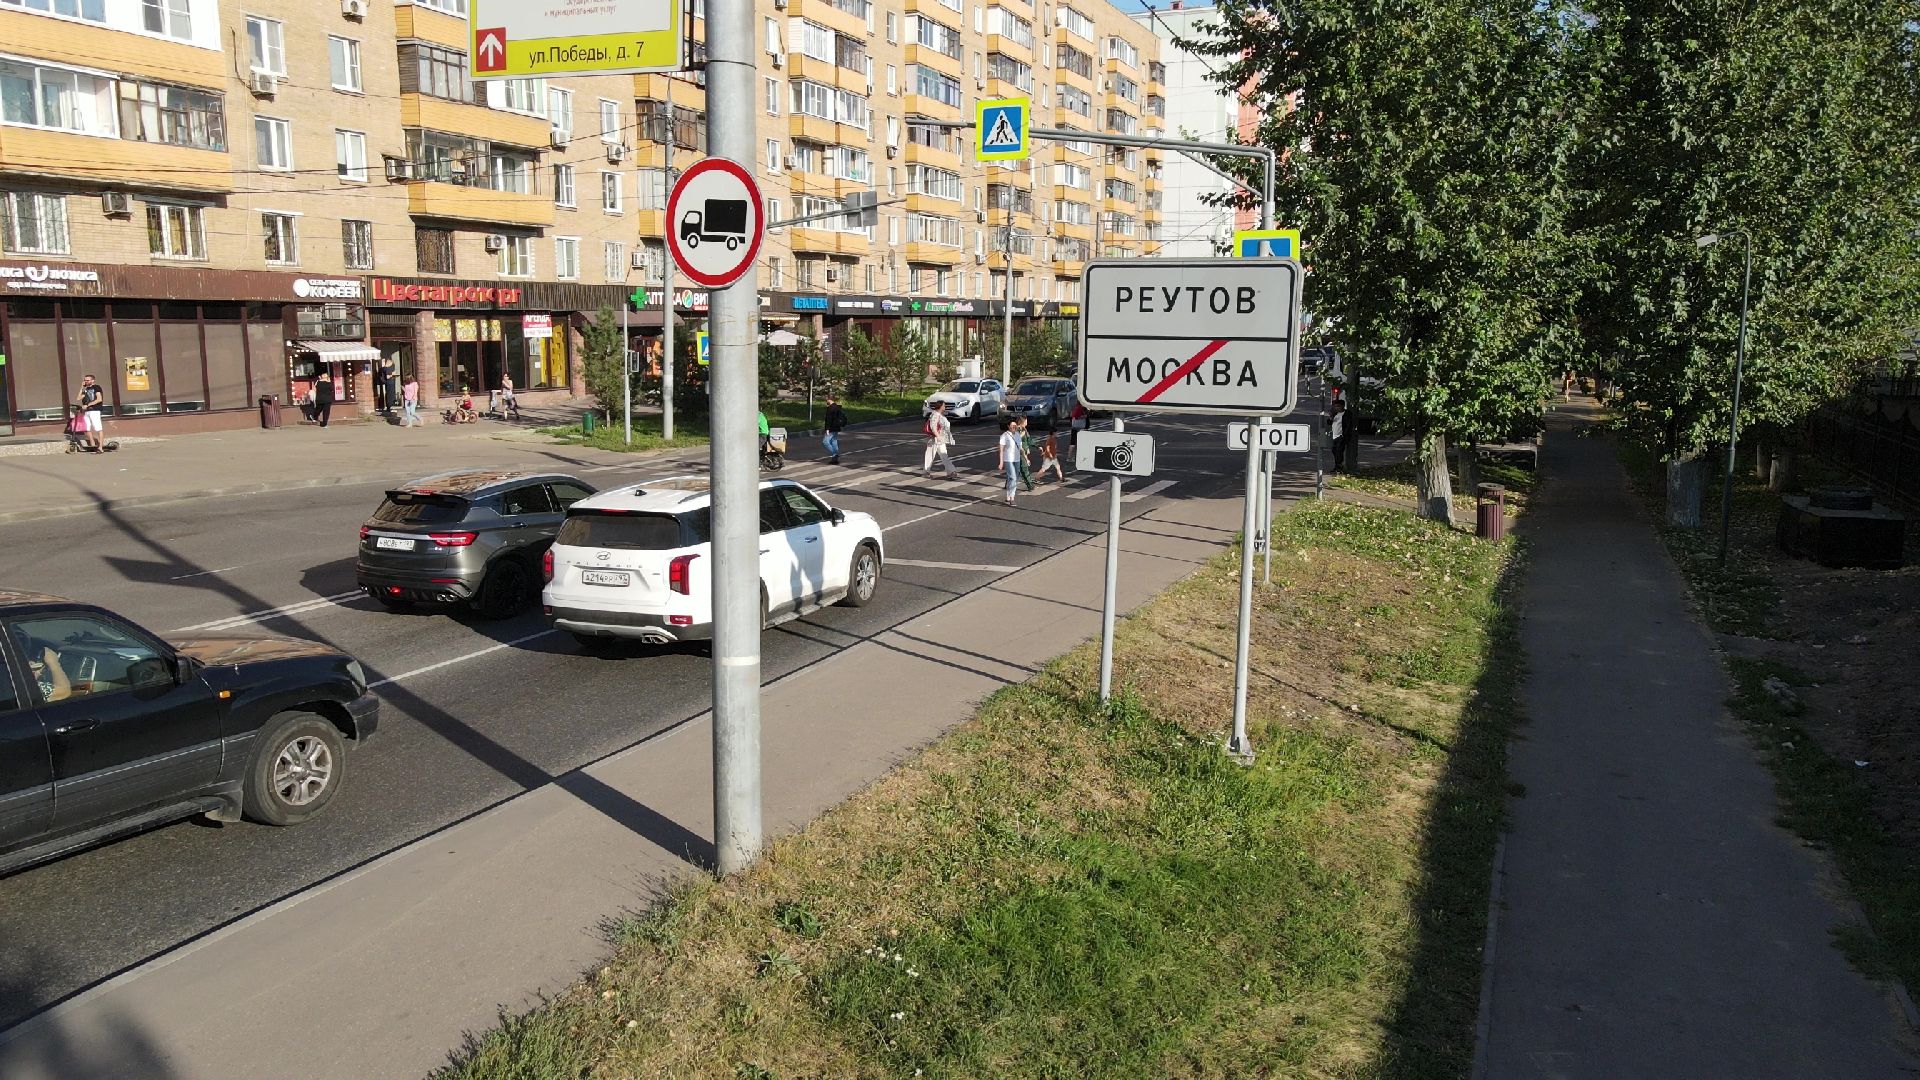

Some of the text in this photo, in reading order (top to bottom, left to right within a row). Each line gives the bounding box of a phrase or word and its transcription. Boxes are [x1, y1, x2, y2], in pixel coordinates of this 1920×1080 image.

[616, 47, 631, 61] д.
[636, 41, 645, 58] 7
[372, 278, 521, 307] Цветагроторг
[1115, 286, 1256, 314] РЕУТОВ
[1106, 356, 1258, 388] МОСКВА
